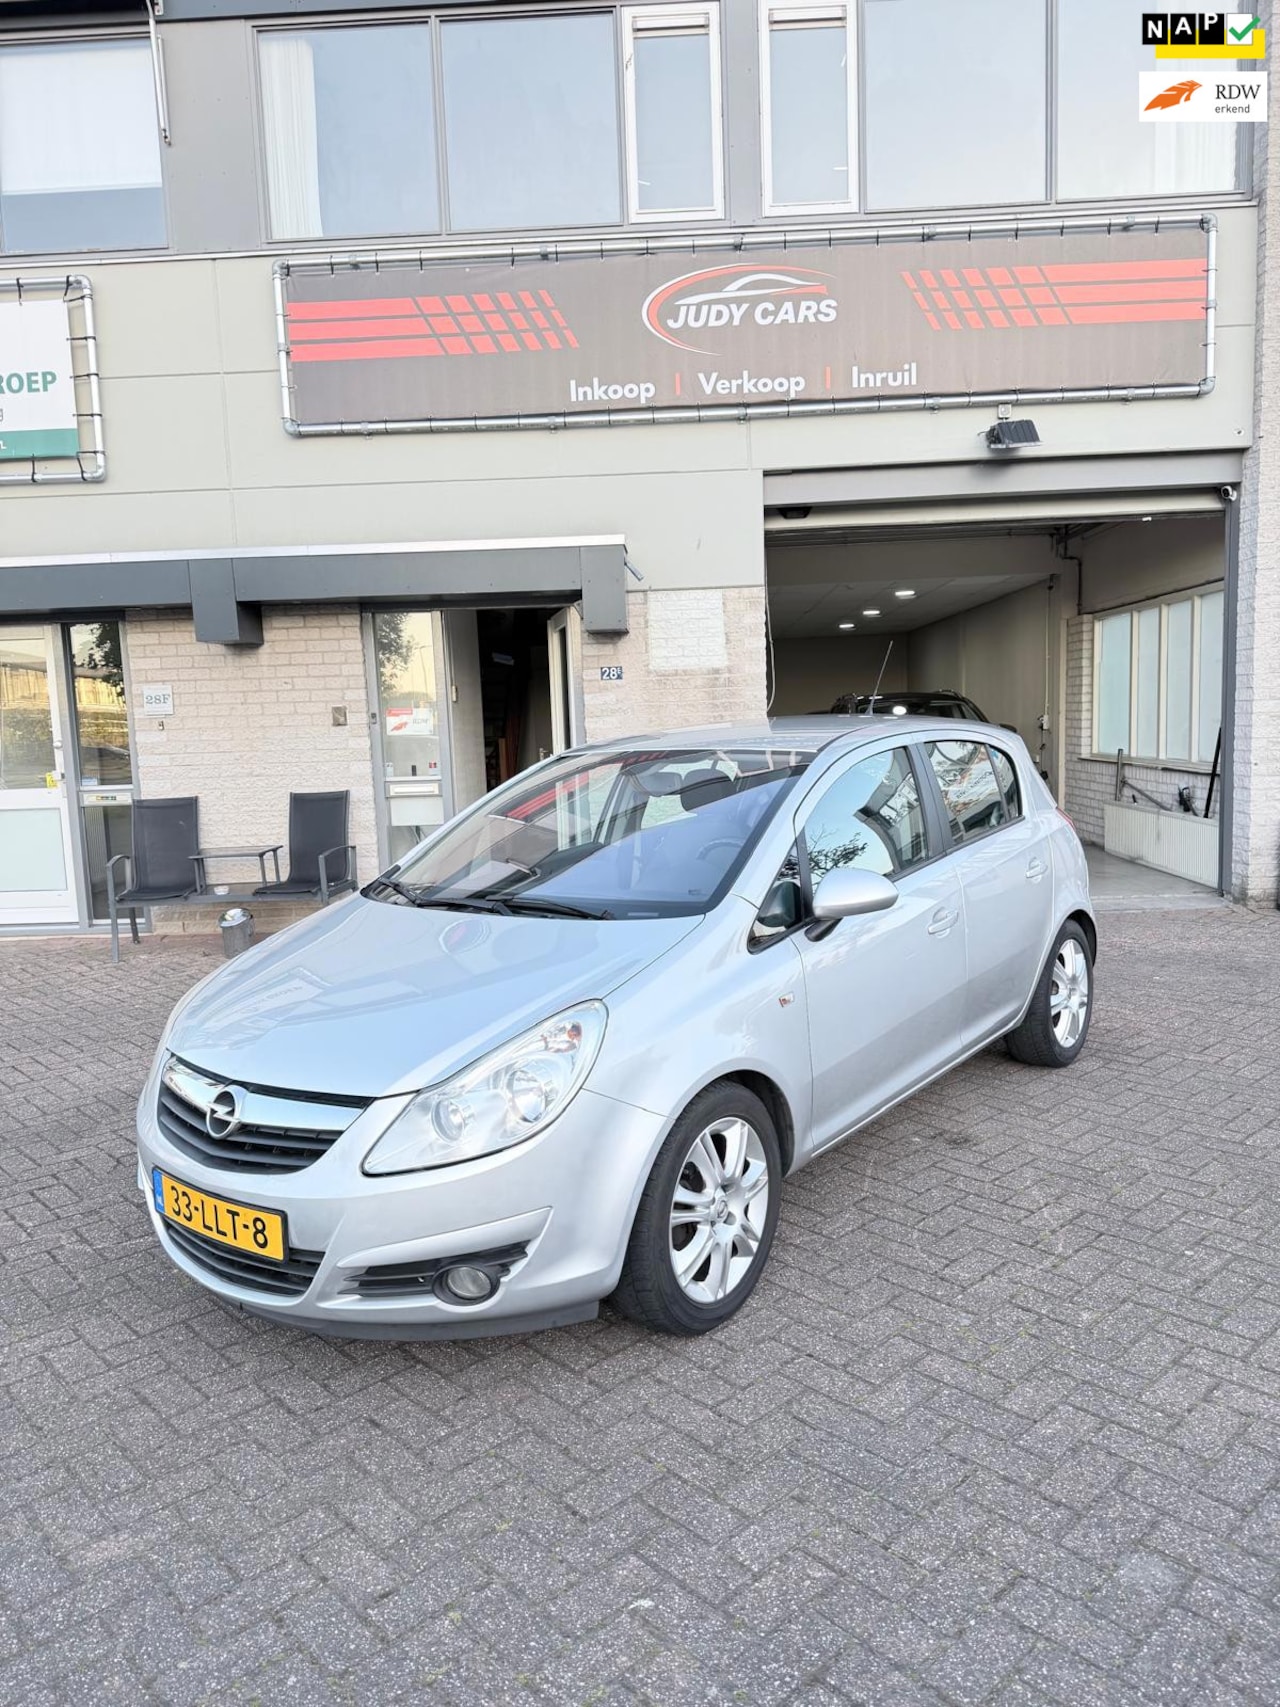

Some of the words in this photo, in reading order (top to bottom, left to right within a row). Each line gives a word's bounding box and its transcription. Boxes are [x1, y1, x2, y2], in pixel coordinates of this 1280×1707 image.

[667, 303, 750, 329] JUDY
[754, 299, 838, 325] CARS
[570, 377, 656, 404] Inkoop
[697, 370, 805, 399] Verkoop
[852, 362, 917, 388] Inruil
[145, 694, 170, 704] 28F
[171, 1185, 268, 1249] 33-LLT-8
